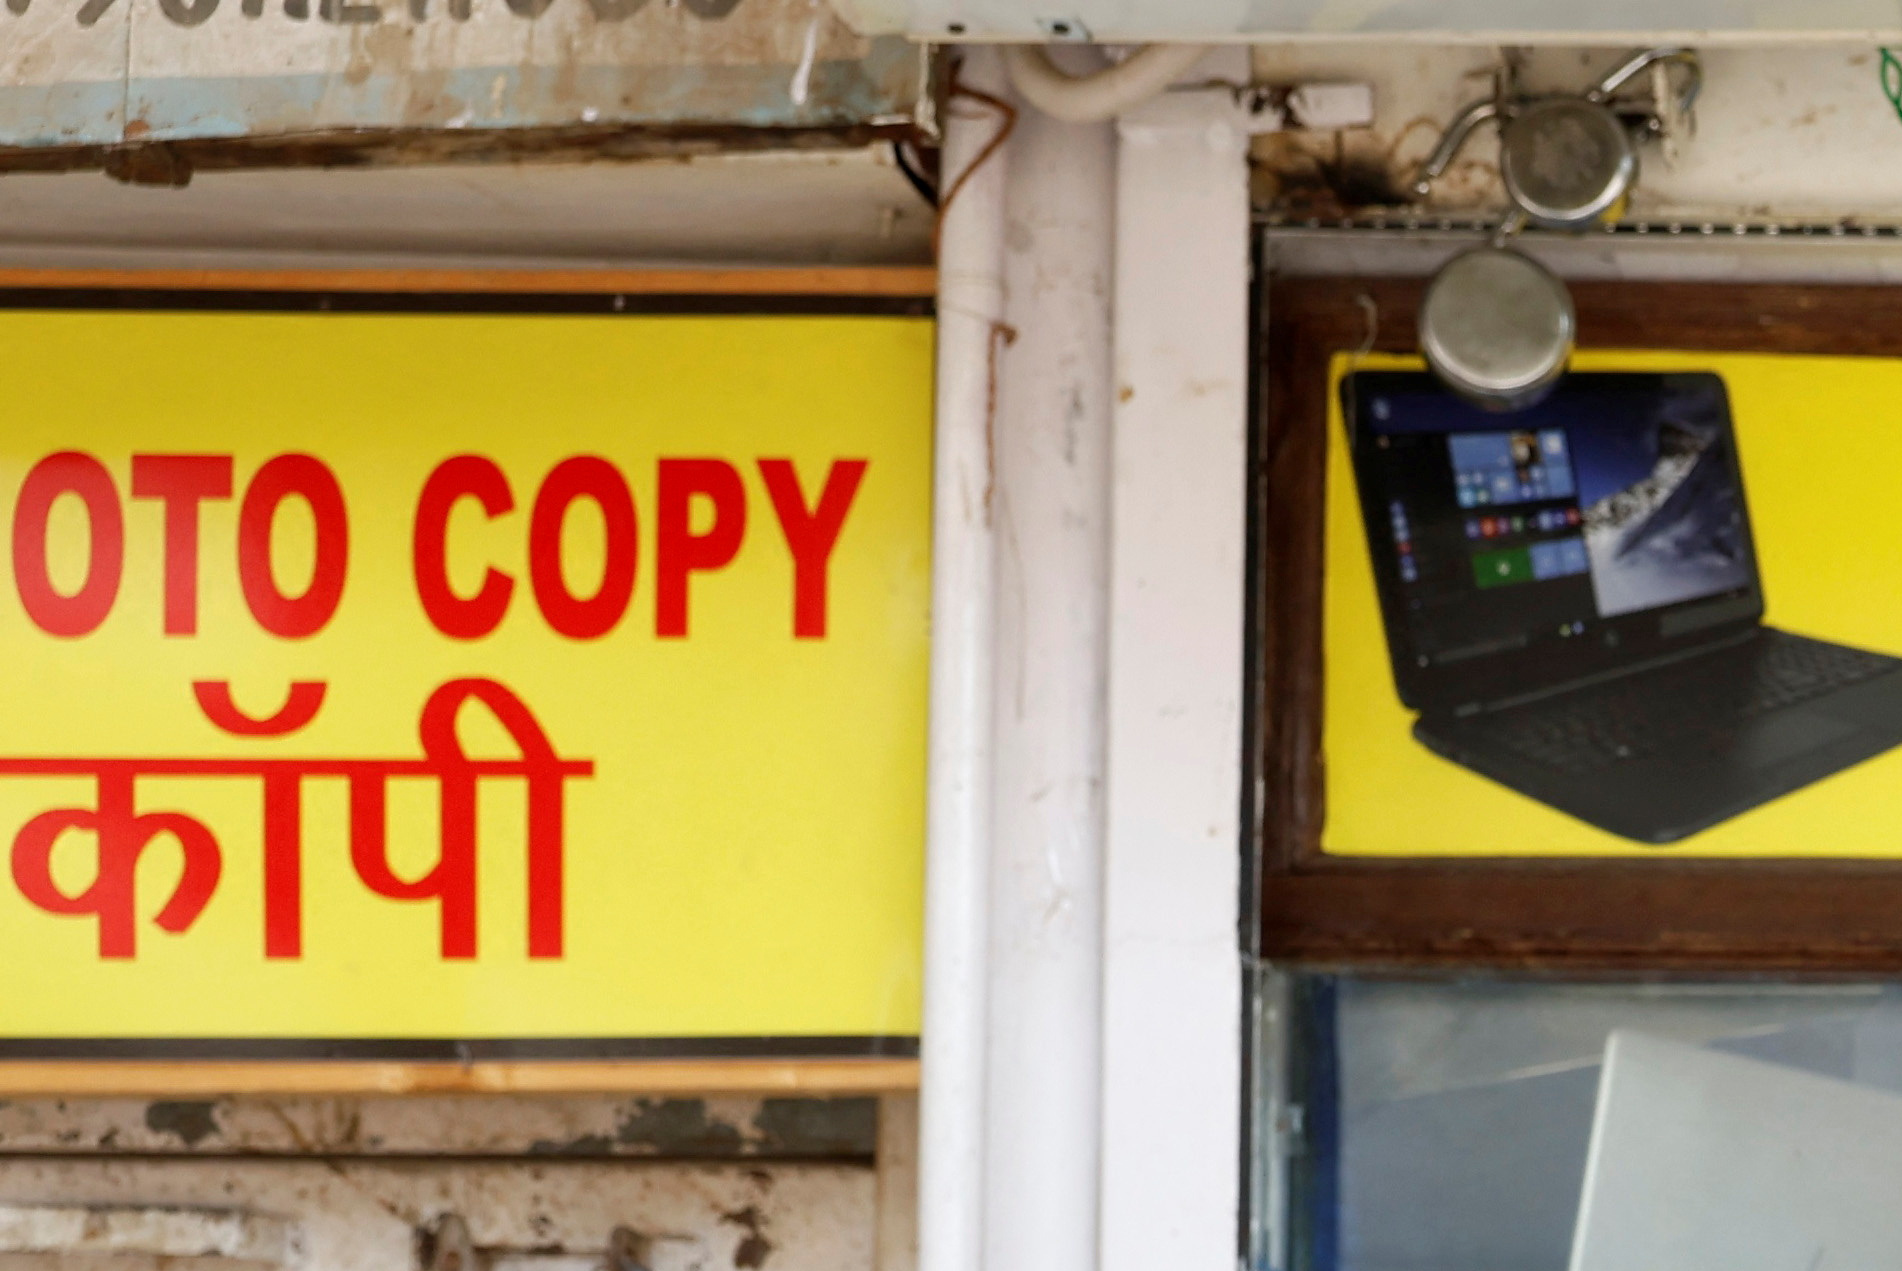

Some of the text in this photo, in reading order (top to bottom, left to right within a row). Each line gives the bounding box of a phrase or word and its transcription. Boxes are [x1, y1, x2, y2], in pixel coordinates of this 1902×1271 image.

[13, 449, 869, 641] OTO COPY
[0, 676, 595, 961] कॉपी
